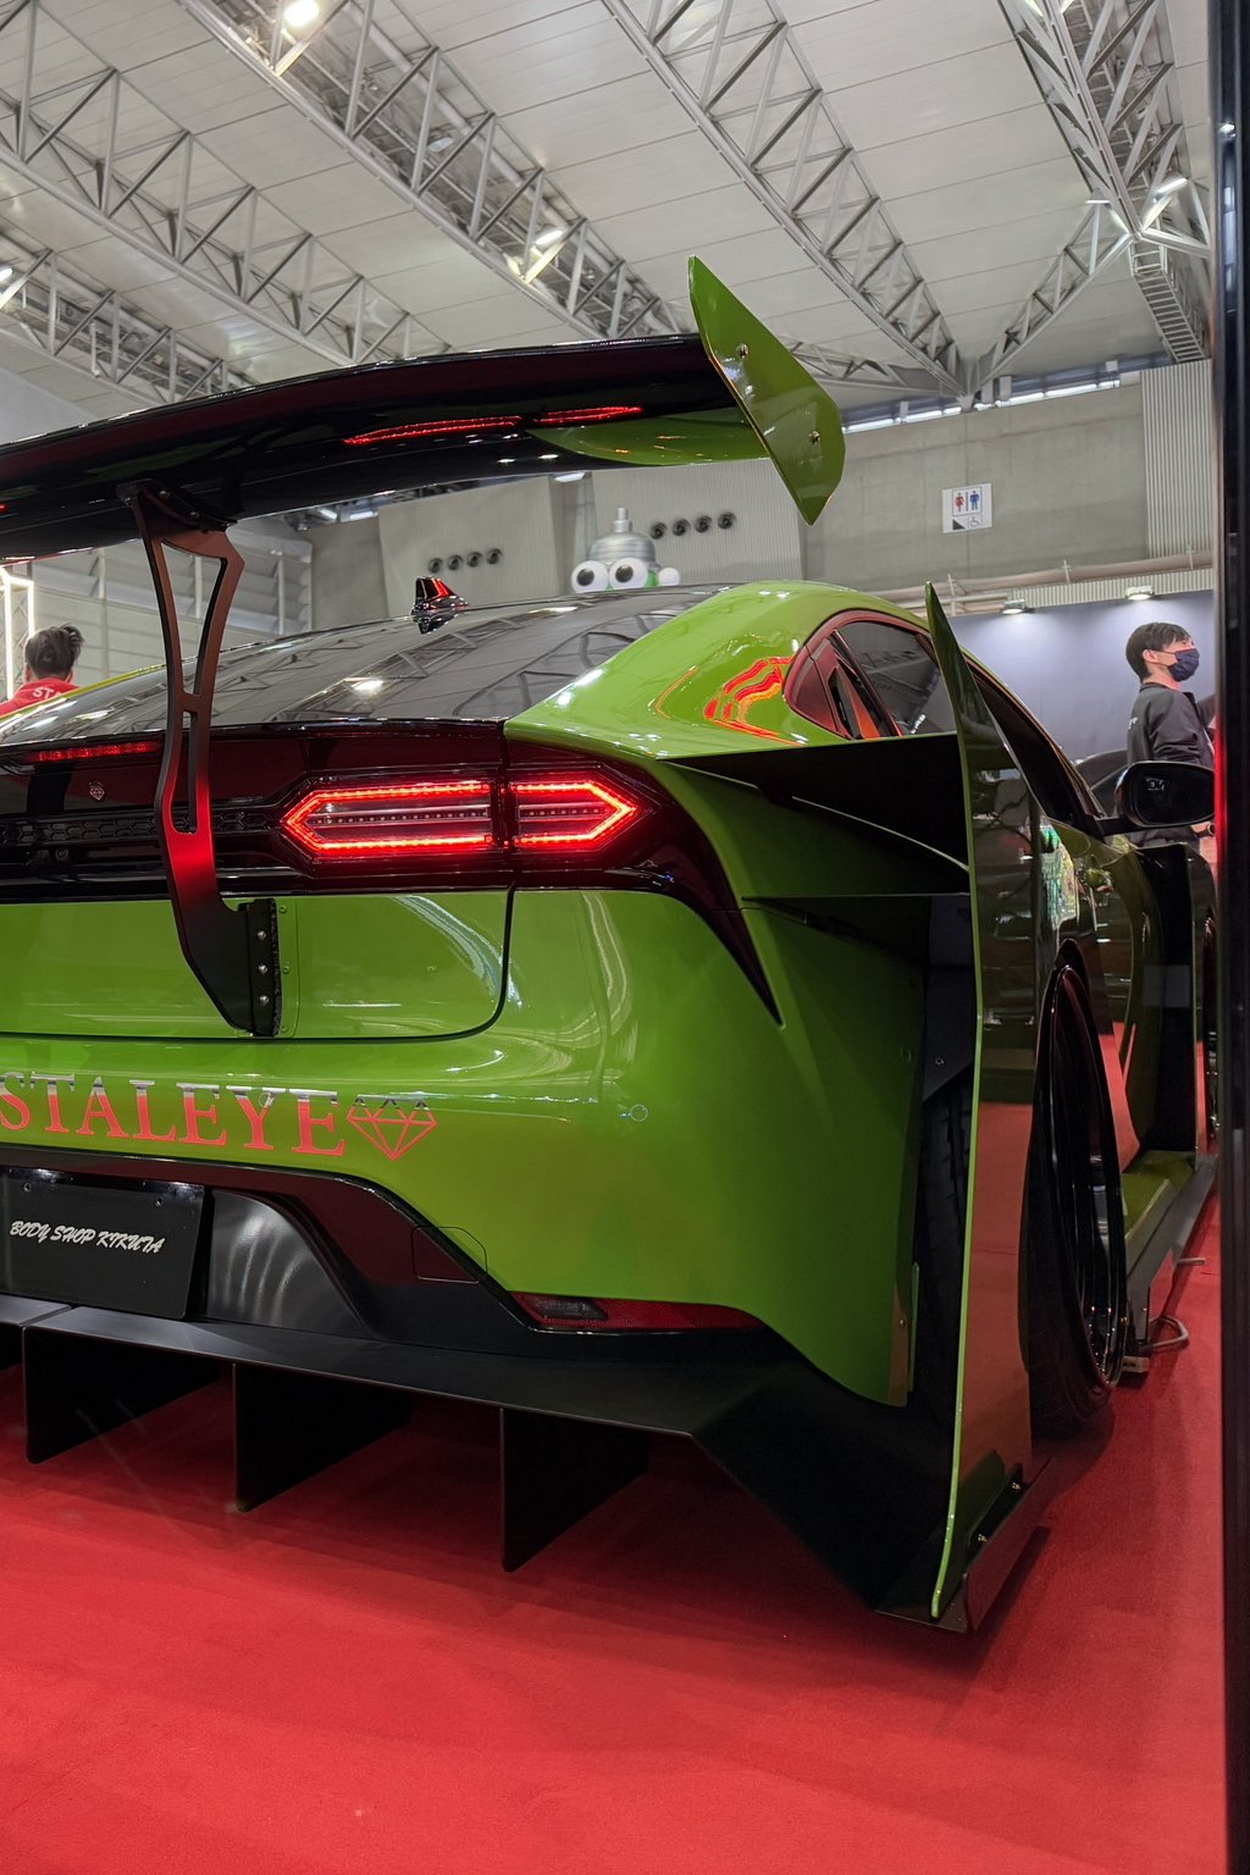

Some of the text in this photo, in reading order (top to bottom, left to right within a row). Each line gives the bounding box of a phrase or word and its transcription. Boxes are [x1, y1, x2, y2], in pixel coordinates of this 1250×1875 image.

[9, 1220, 165, 1253] BODY SHOP KIKUTA
